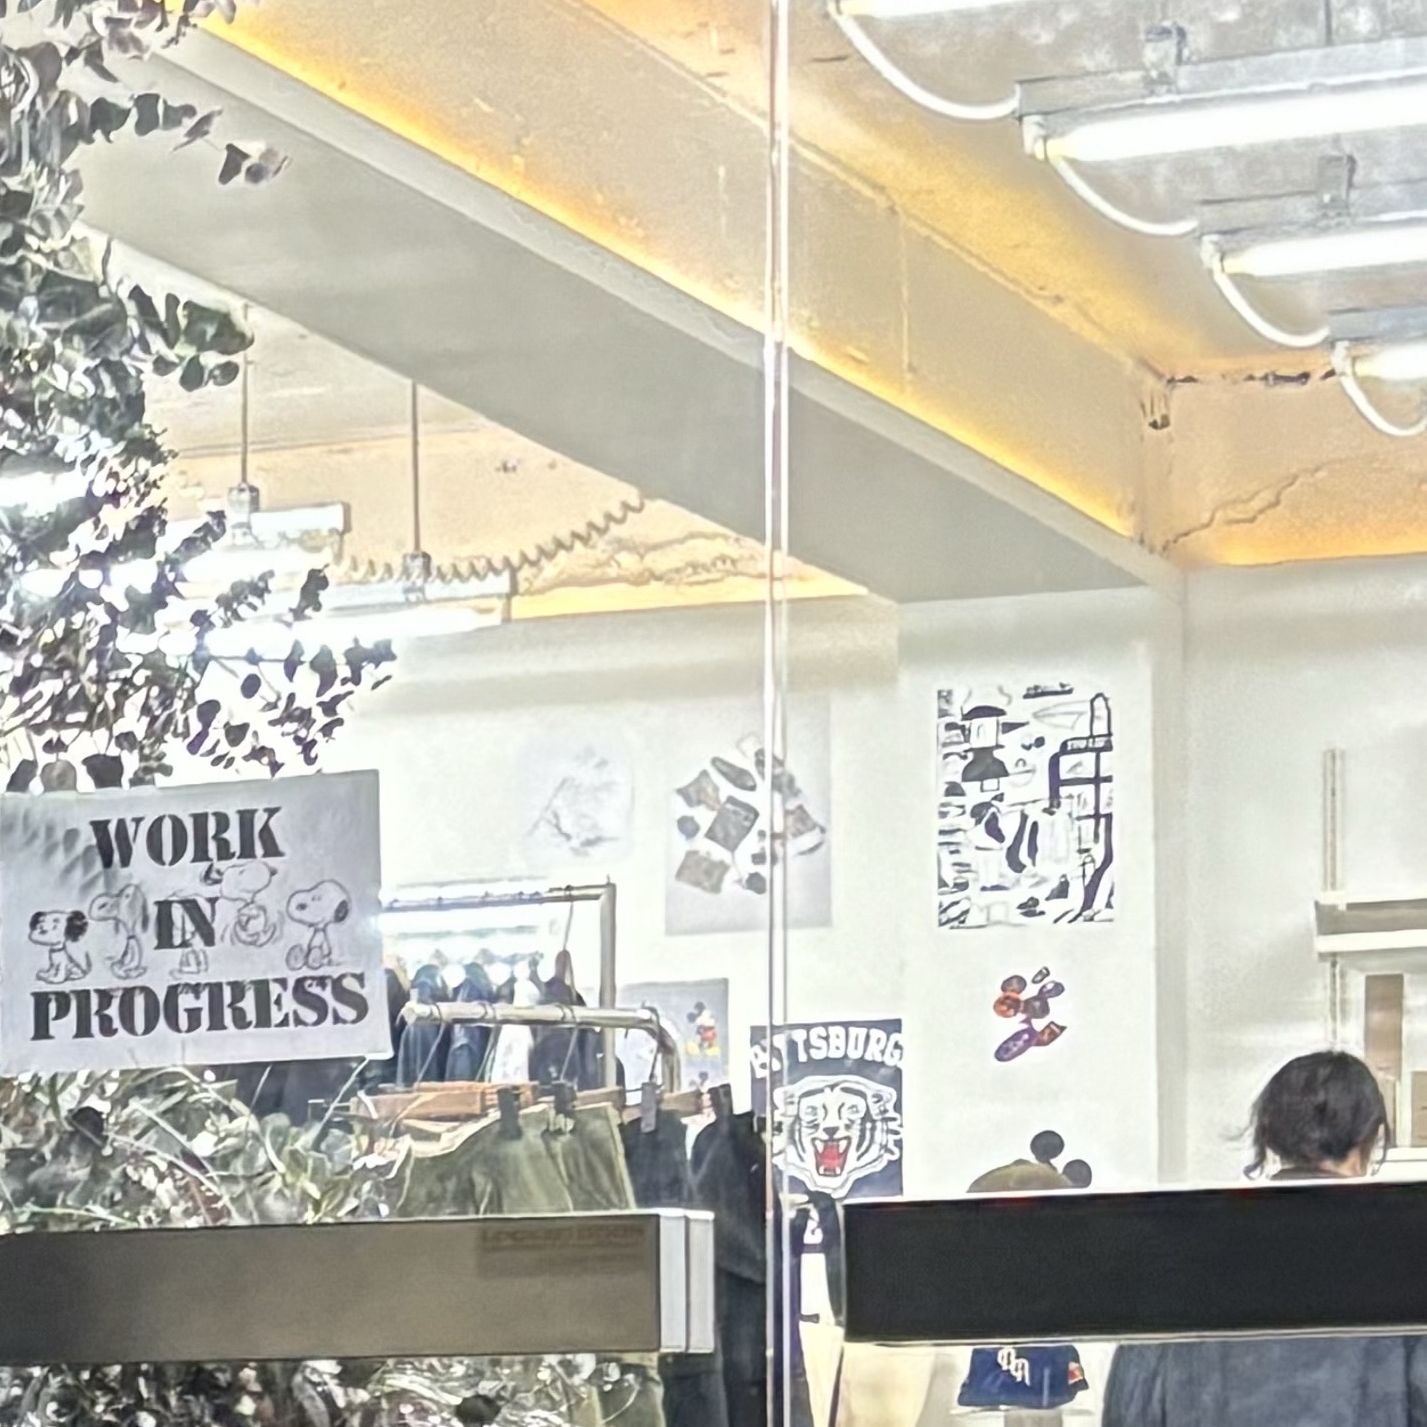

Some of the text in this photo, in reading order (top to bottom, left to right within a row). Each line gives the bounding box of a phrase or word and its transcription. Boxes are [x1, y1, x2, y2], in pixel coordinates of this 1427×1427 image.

[89, 806, 285, 869] WORK
[152, 897, 218, 951] IN
[29, 971, 370, 1042] PROGRESS
